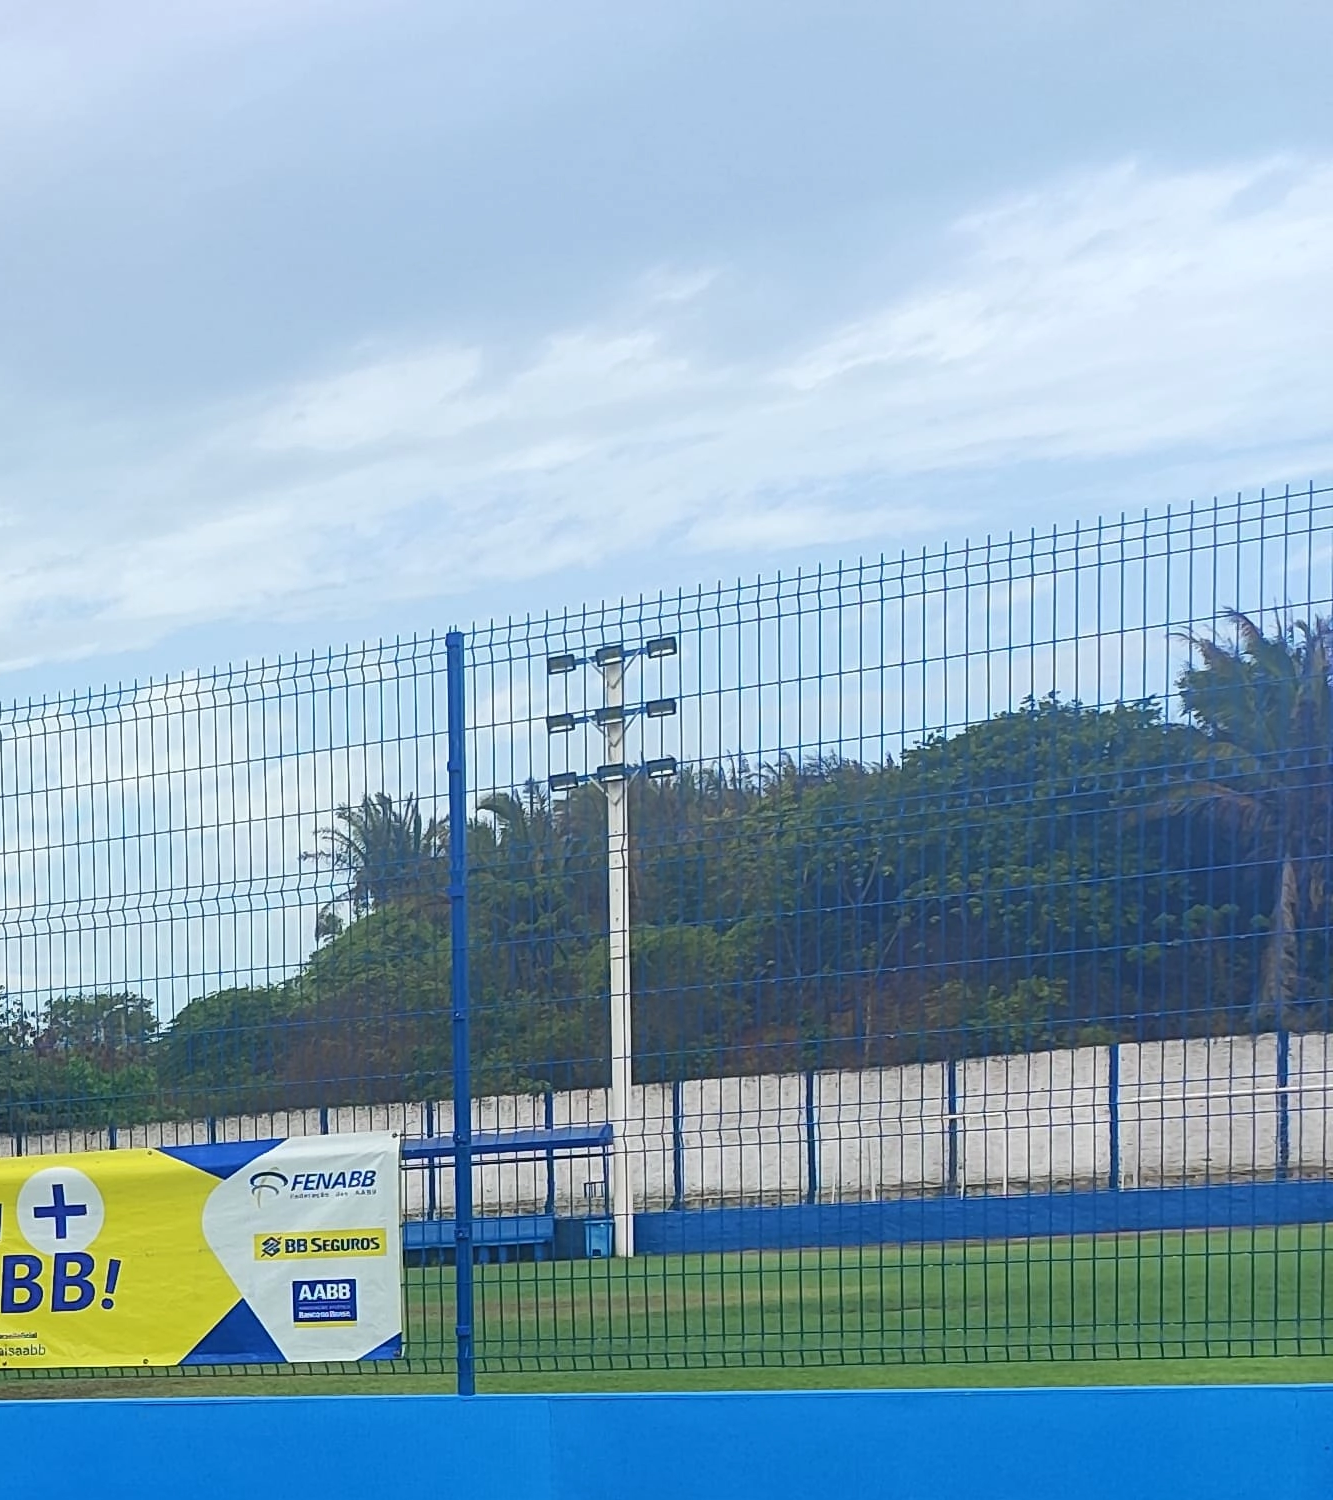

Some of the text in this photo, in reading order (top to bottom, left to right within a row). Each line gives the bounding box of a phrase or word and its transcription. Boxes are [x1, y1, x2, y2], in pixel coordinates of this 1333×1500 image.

[291, 1170, 377, 1192] FENABB
[284, 1236, 380, 1254] BB SEGUROS
[298, 1283, 351, 1301] AABB
